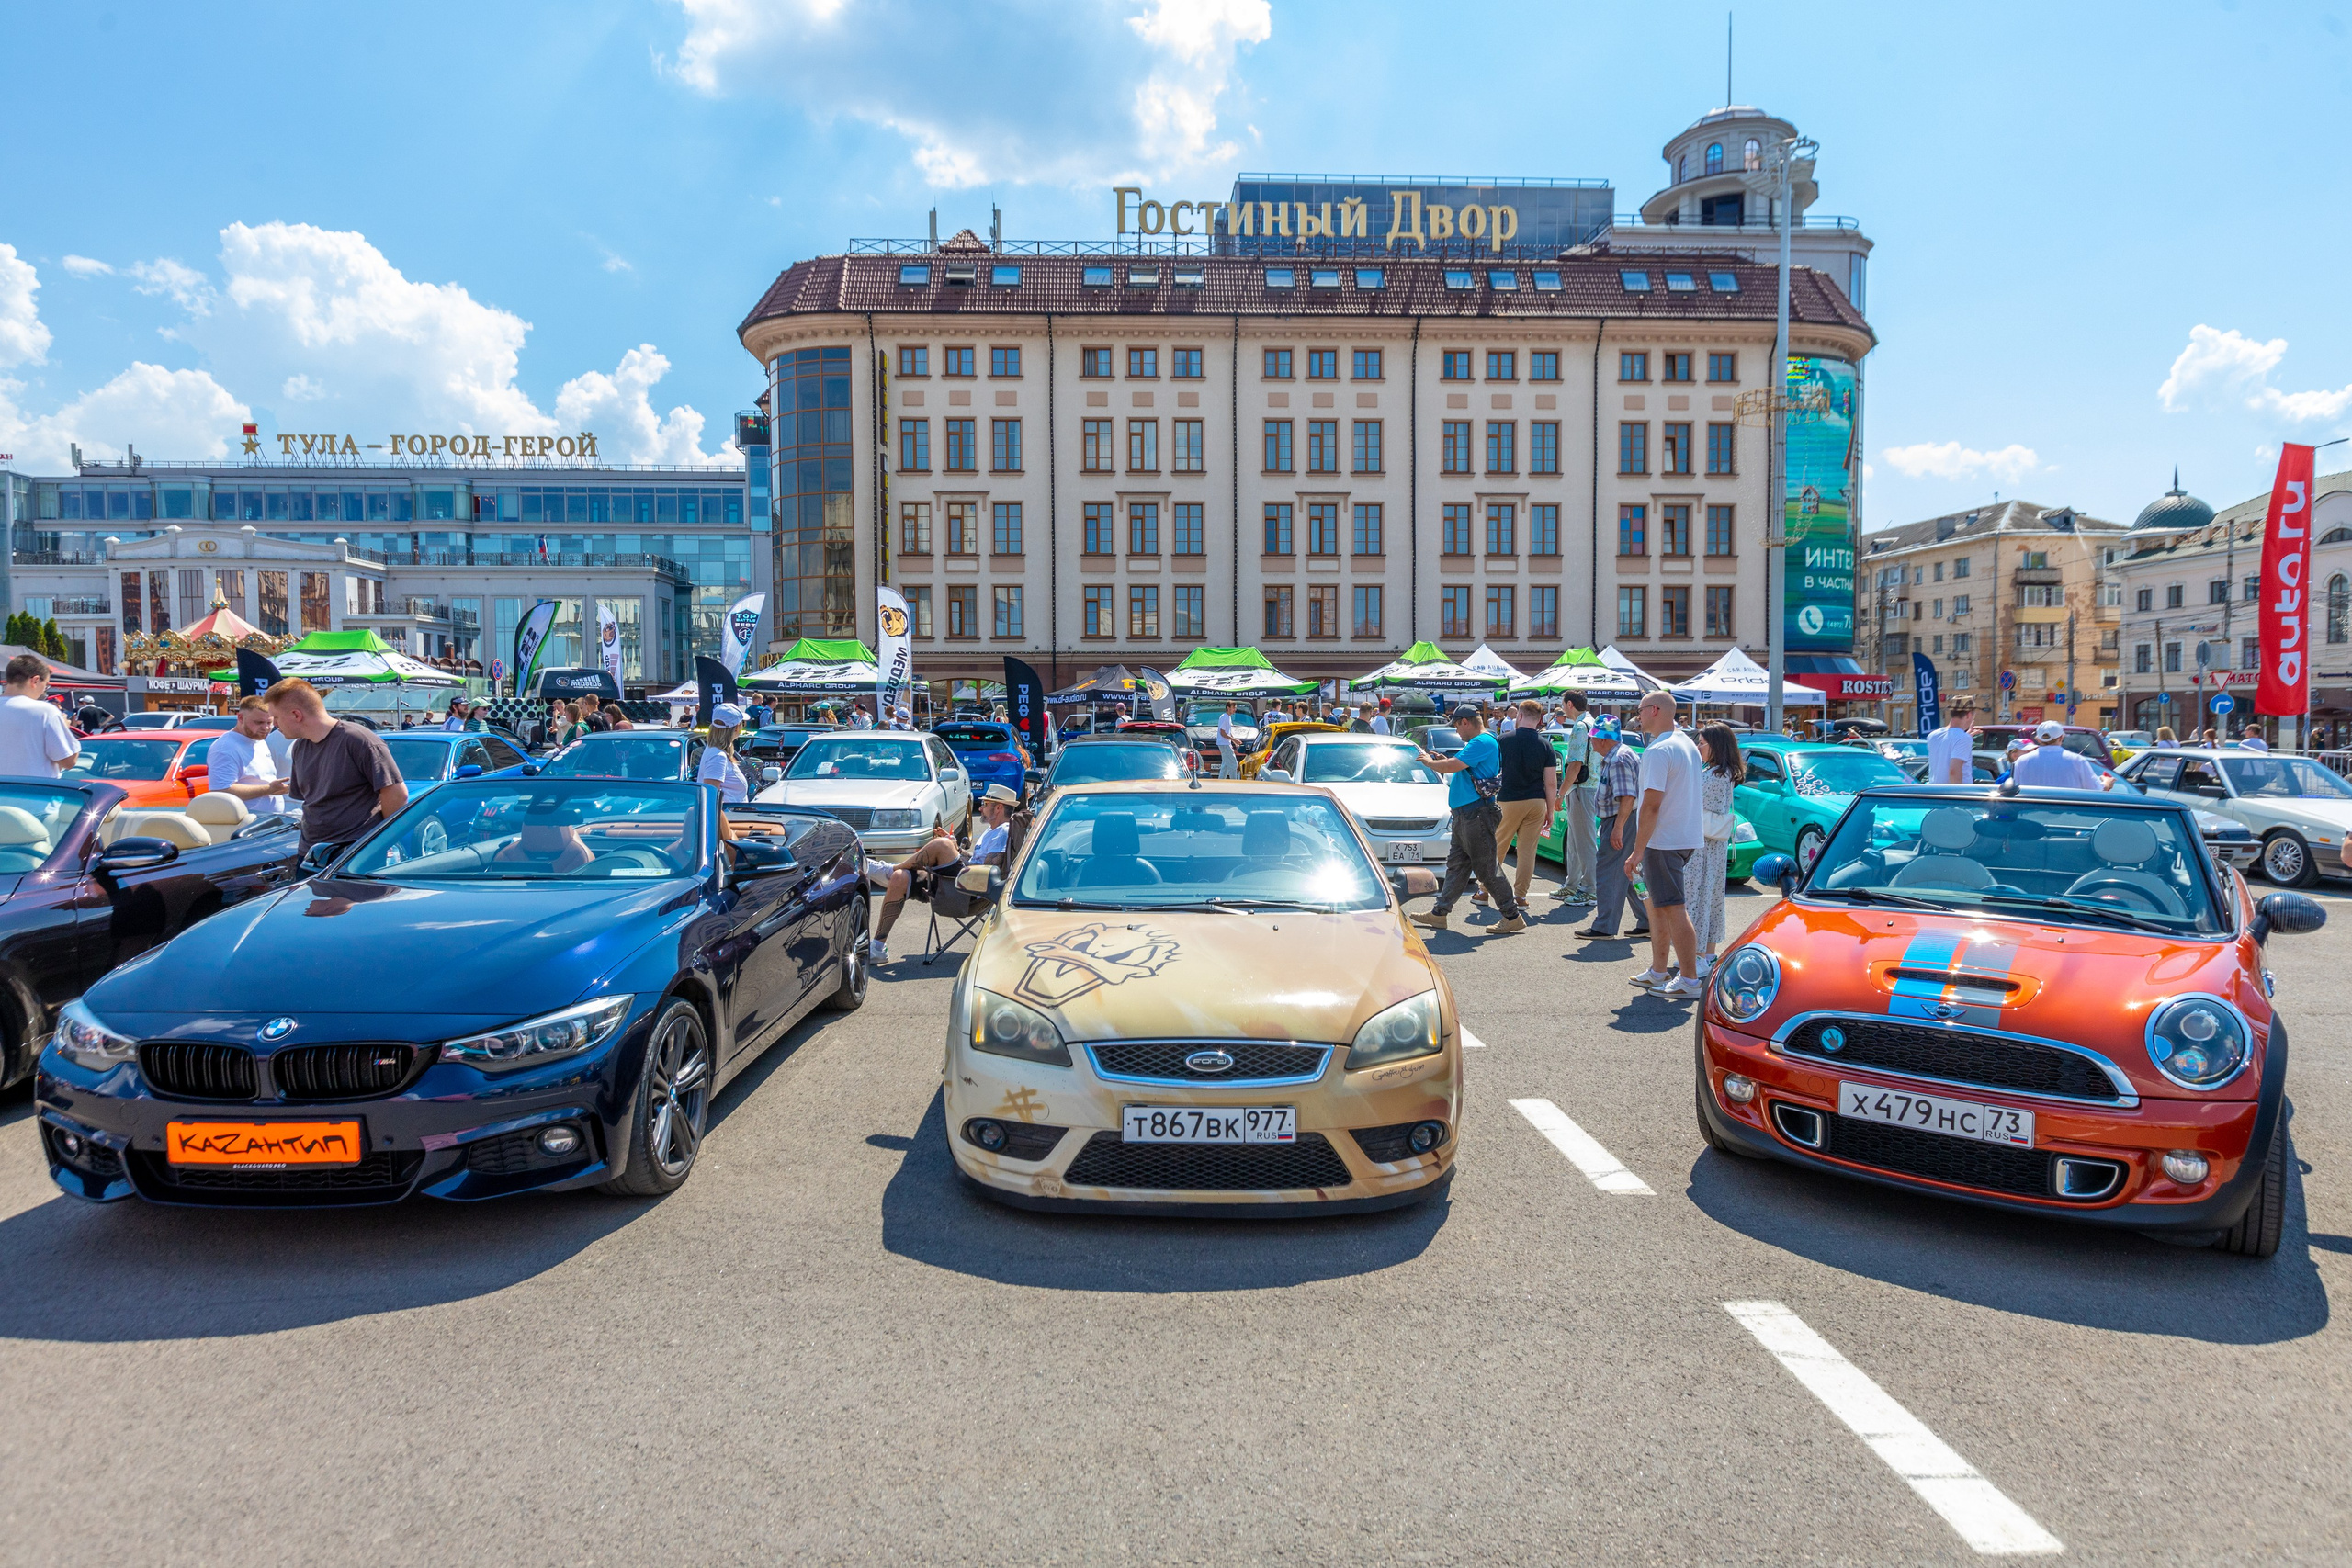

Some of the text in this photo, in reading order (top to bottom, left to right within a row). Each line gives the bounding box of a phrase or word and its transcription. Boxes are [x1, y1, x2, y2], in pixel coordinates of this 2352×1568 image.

[1113, 186, 1518, 252] Гостиный Двор
[277, 434, 359, 456] ТУЛА
[390, 432, 599, 459] ГОРОД-ГЕРОЙ
[1805, 547, 1854, 570] ИНТЕ
[1805, 576, 1815, 588] В
[2274, 480, 2306, 687] auto.ru
[149, 679, 170, 690] КОФЕ
[177, 680, 209, 691] ШАУРМА
[1404, 843, 1418, 852] 753
[1246, 1111, 1288, 1132] 977
[1988, 1109, 2020, 1134] 73
[1256, 1131, 1277, 1140] RUS
[1985, 1130, 2010, 1141] RUS
